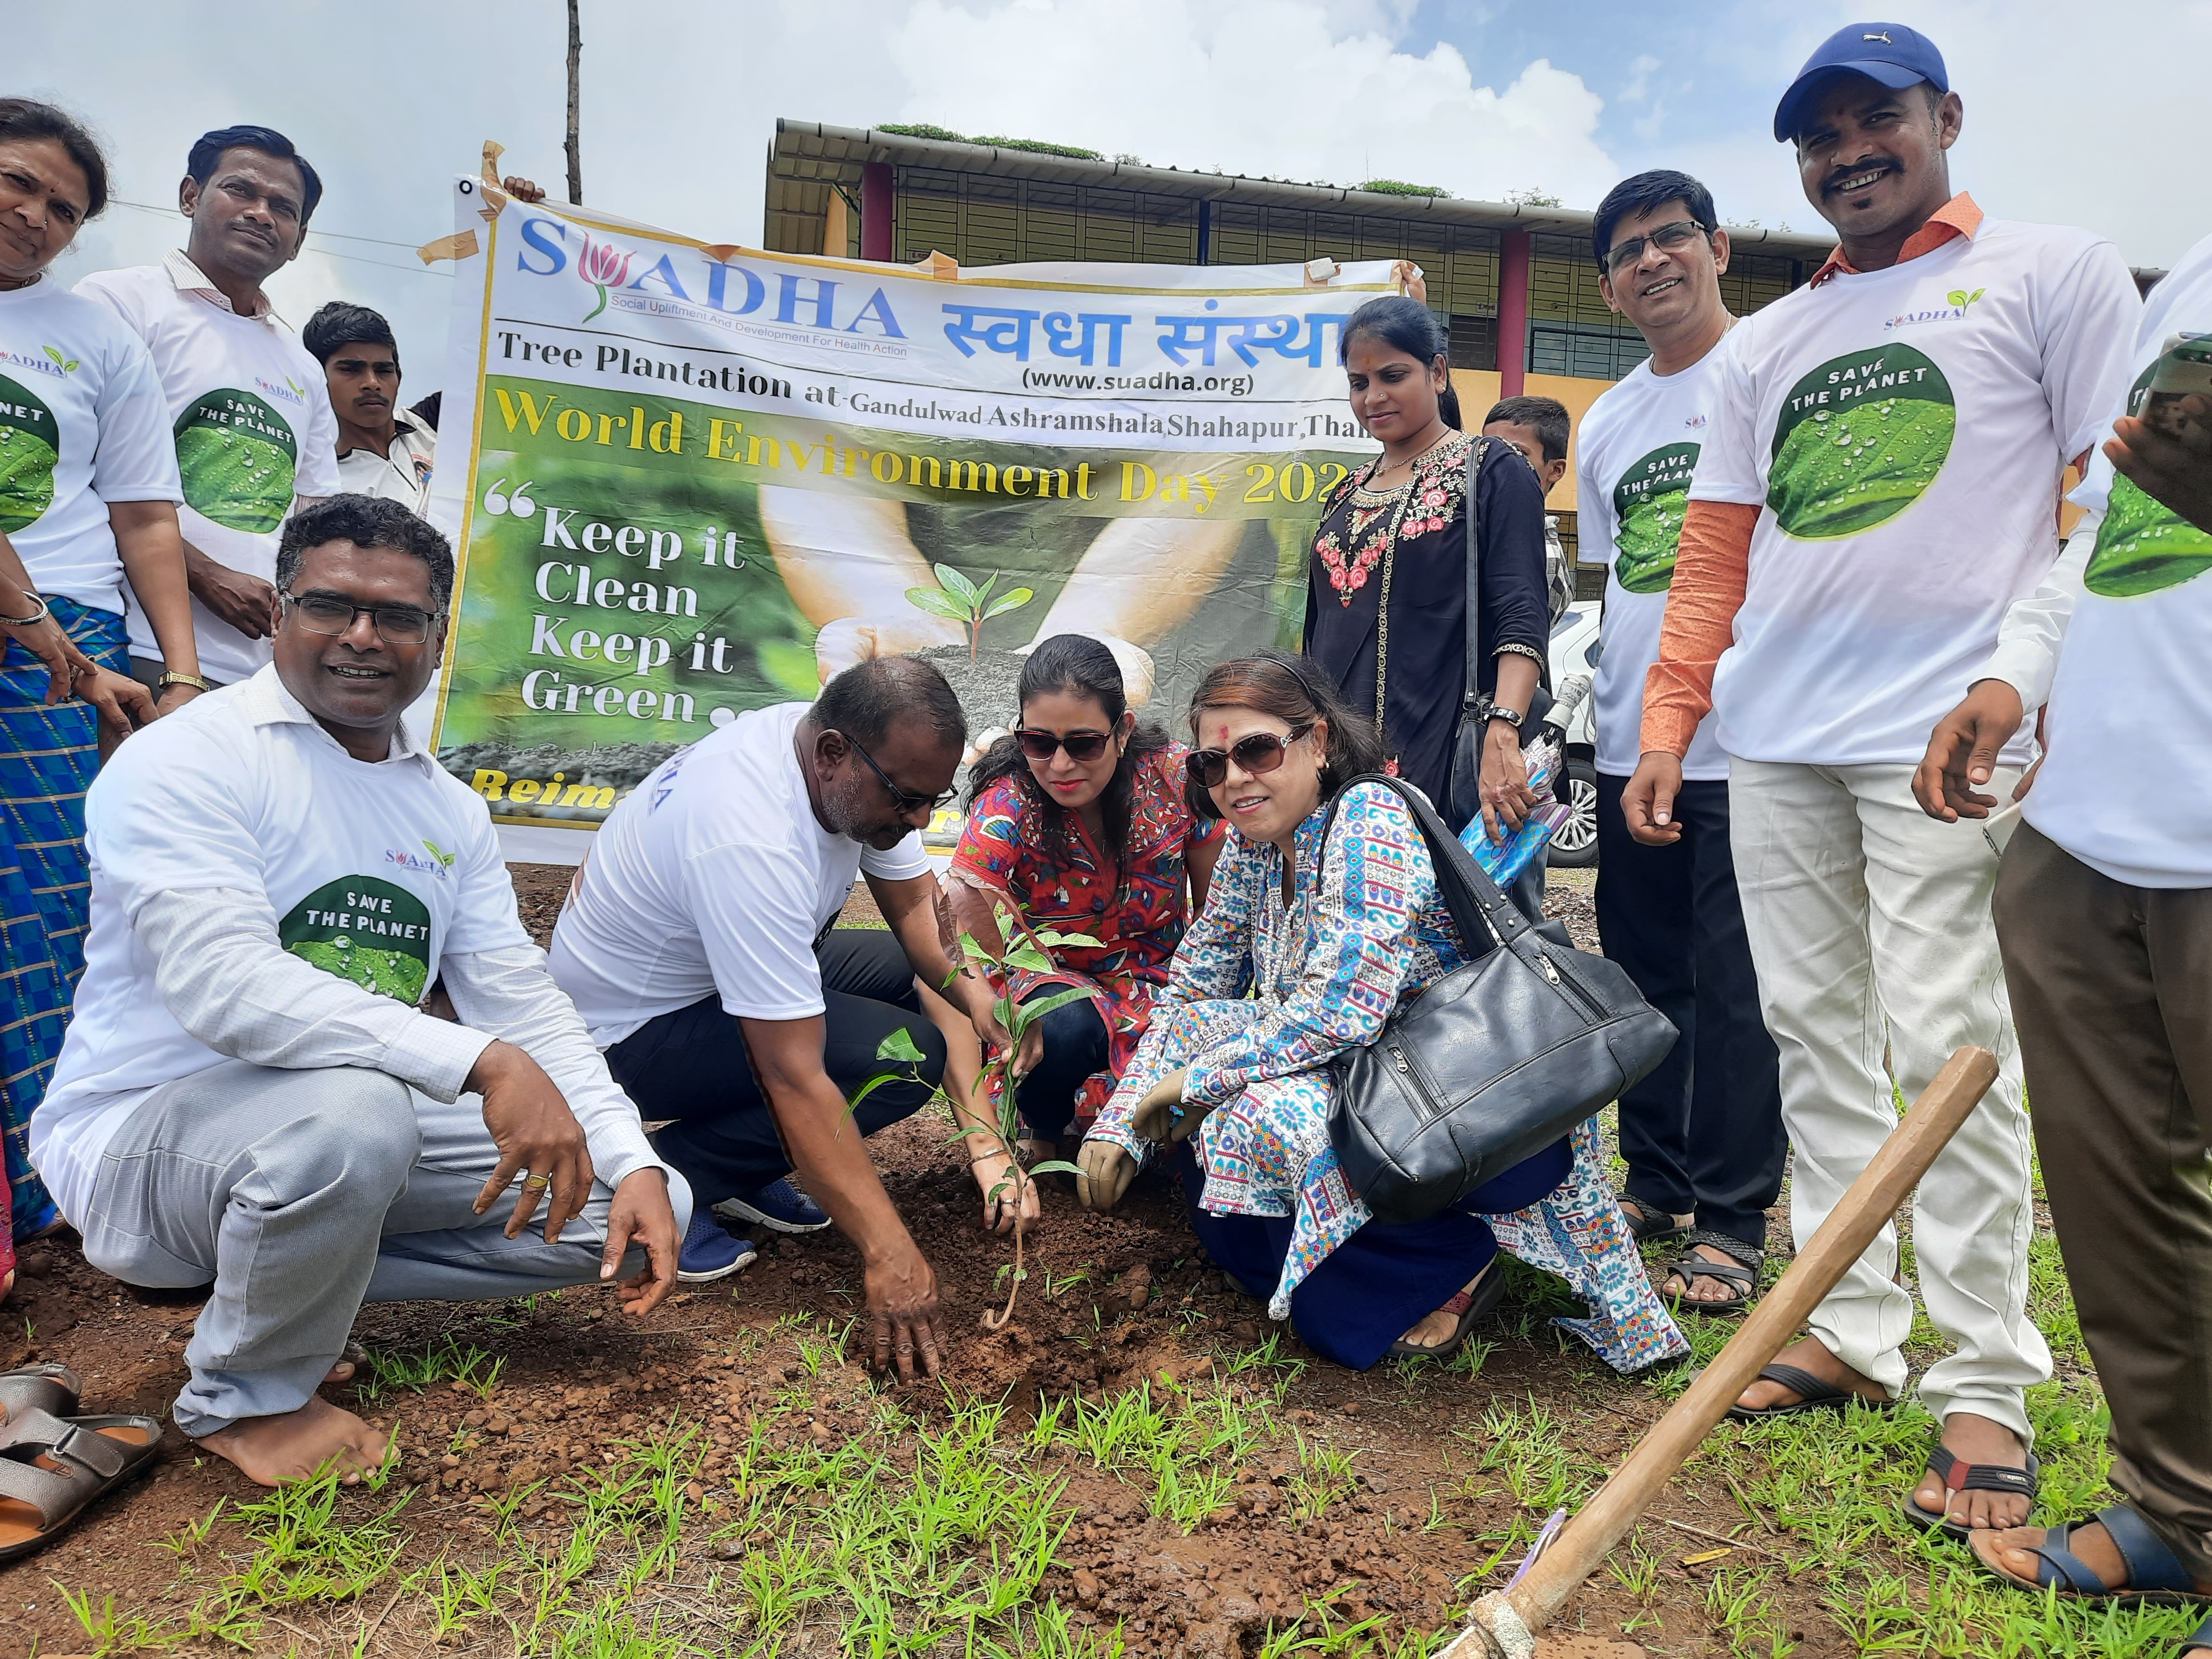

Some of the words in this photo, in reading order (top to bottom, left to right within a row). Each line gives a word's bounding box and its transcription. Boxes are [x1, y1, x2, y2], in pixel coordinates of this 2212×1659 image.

[611, 296, 646, 310] Social
[650, 300, 707, 320] Upliftment
[709, 315, 731, 328] And
[735, 322, 810, 343] Development
[813, 335, 832, 346] For
[834, 338, 870, 352] Health
[873, 343, 907, 356] Action
[942, 302, 1131, 367] स्वधा
[498, 332, 582, 368] Tree
[595, 345, 792, 399] Plantation
[1021, 368, 1255, 396] (www.suadha.org)
[1827, 357, 1885, 384] SAVE
[227, 399, 265, 420] SAVE
[1791, 390, 1830, 411] THE
[1839, 367, 1928, 401] PLANET
[199, 406, 229, 424] THE
[234, 416, 292, 443] PLANET
[492, 388, 682, 455] World
[703, 416, 1099, 502] Environment
[1117, 461, 1229, 514] Day
[1647, 454, 1688, 473] SAVE
[1621, 478, 1651, 496] THE
[700, 525, 745, 570] it
[534, 560, 698, 618] Clean
[528, 614, 671, 676] Keep
[688, 632, 734, 674] it
[471, 768, 635, 810] Reim
[347, 891, 393, 914] SAVE
[306, 910, 351, 928] THE
[357, 915, 429, 941] PLANET
